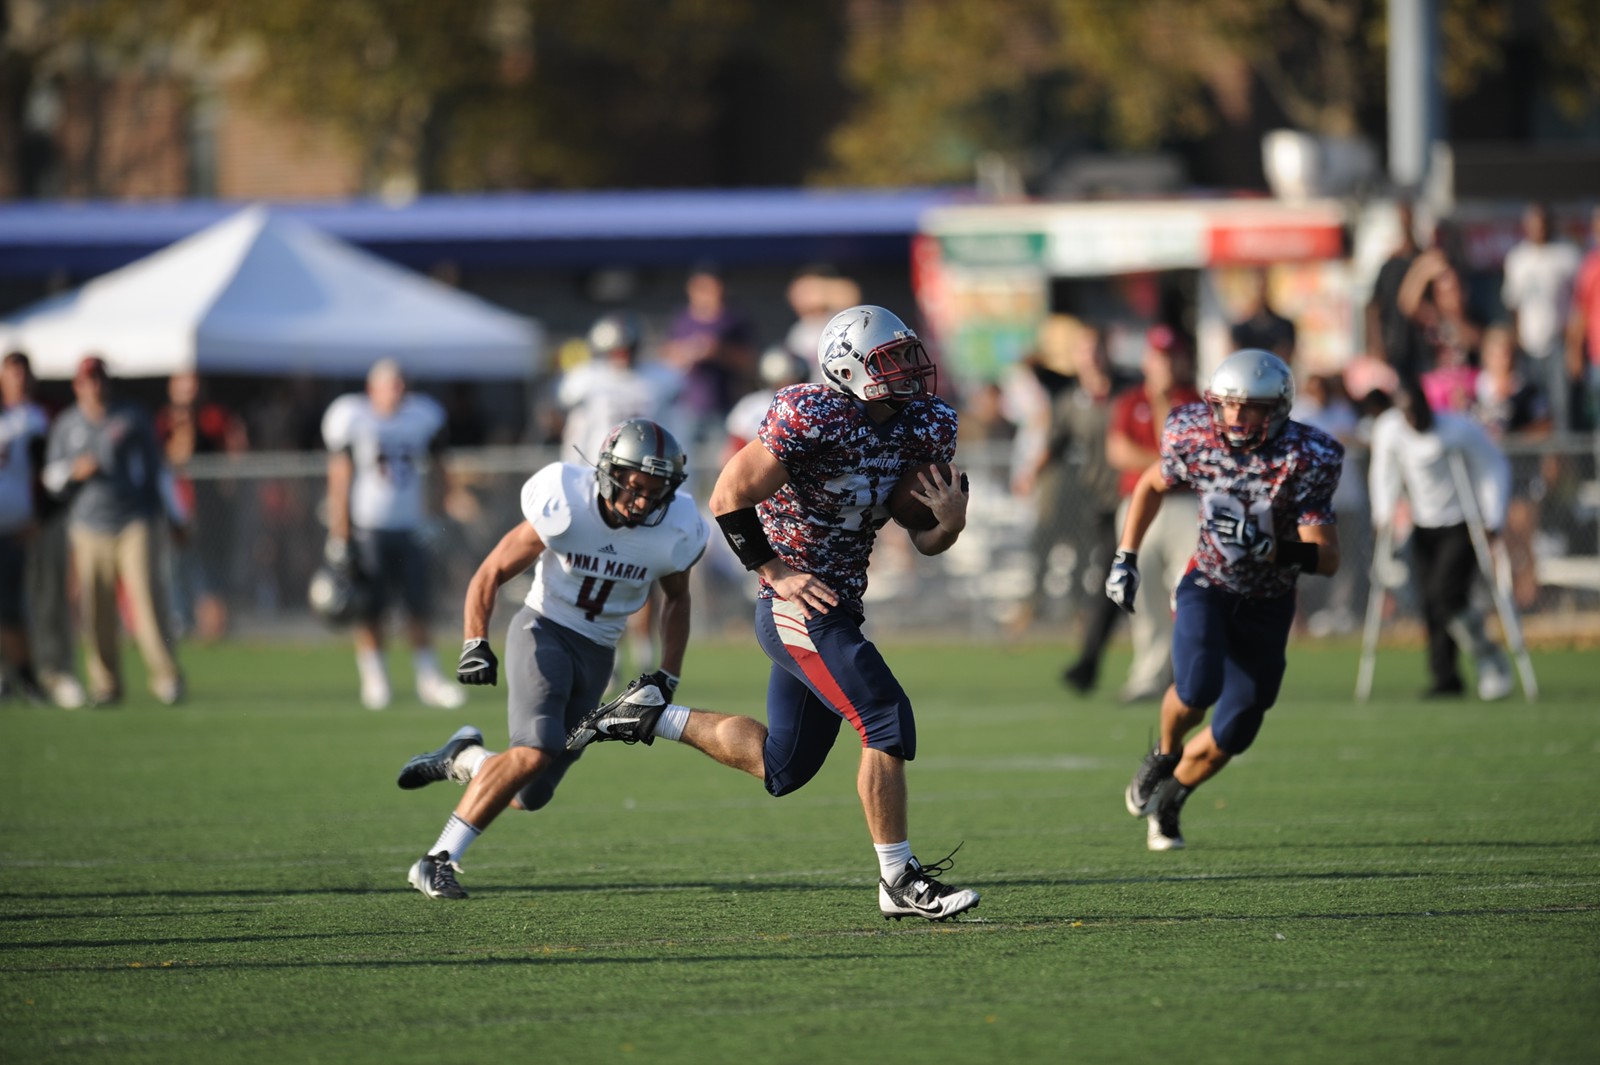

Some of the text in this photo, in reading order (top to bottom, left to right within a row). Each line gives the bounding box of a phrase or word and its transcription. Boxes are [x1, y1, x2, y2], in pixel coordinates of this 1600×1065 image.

[565, 552, 648, 581] ANNA MARIA
[575, 576, 616, 622] 4
